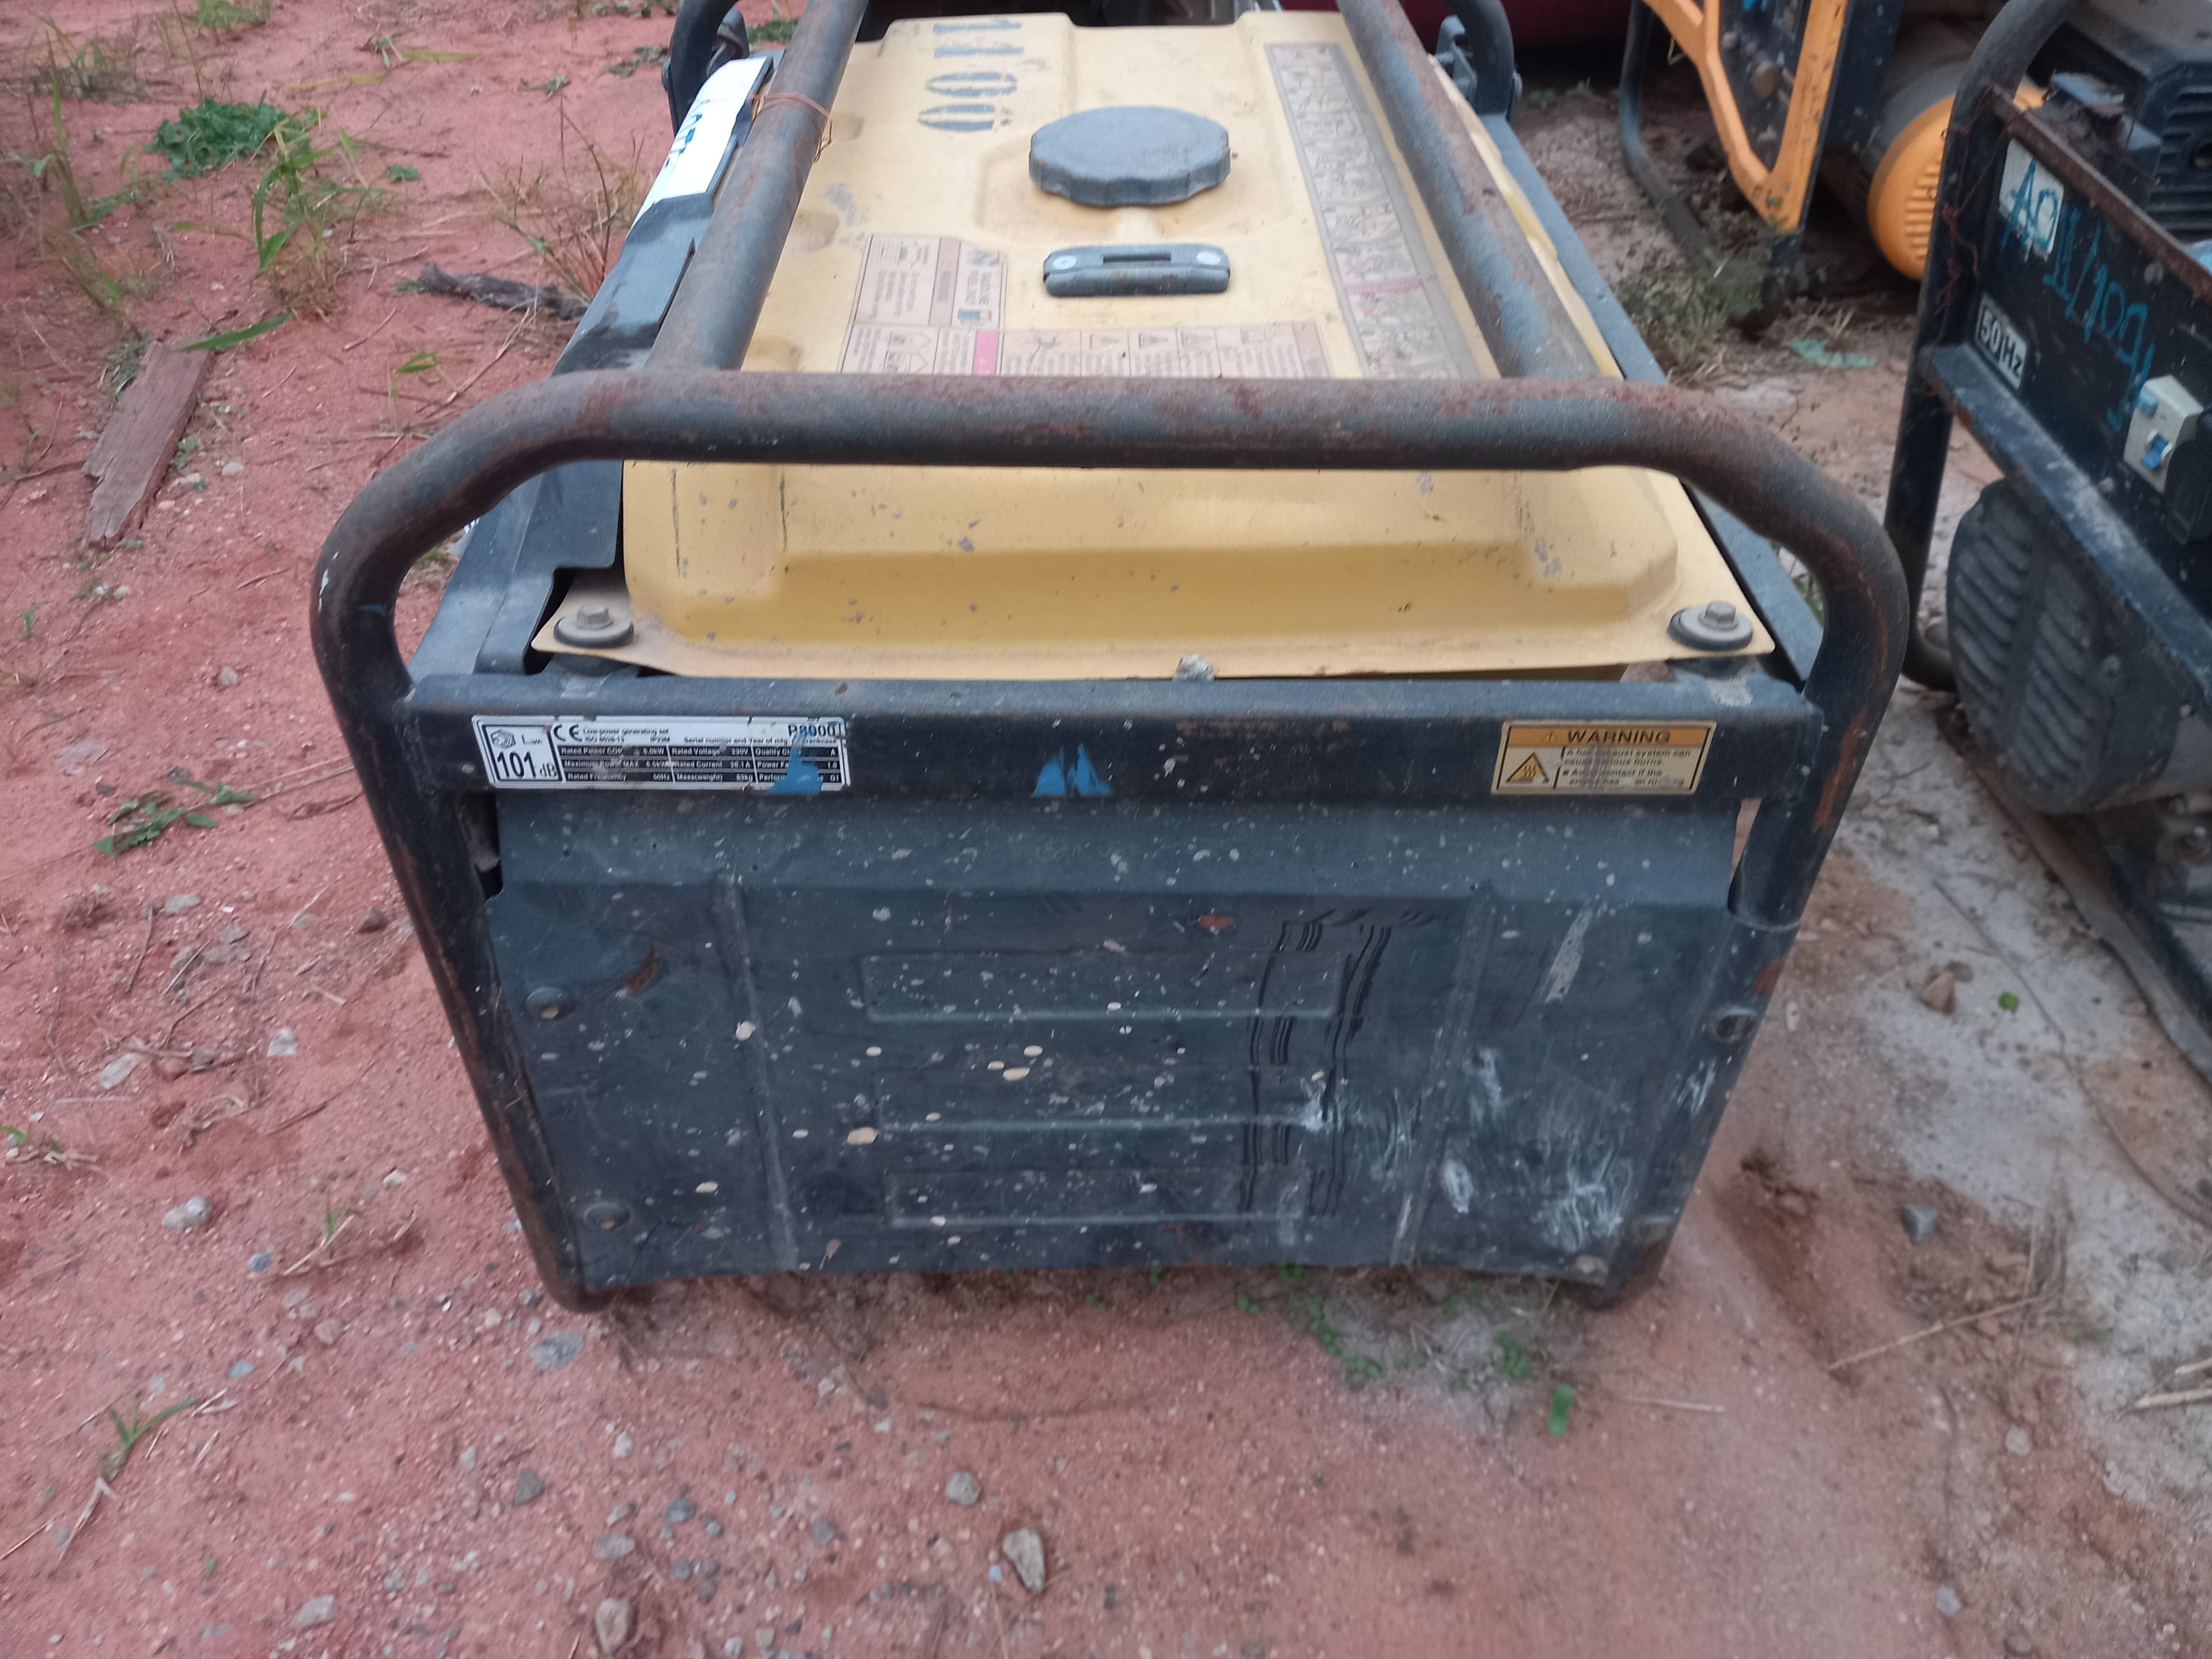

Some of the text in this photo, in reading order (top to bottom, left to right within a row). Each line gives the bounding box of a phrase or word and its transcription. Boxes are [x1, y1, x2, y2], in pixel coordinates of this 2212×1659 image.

[553, 724, 582, 742] CE
[1567, 730, 1671, 743] WARNING
[561, 747, 582, 755] Rated
[672, 747, 749, 756] Rated Voltage 230V
[755, 747, 780, 756] Quality
[1635, 750, 1671, 759] system
[497, 751, 557, 778] 101 dB
[757, 761, 779, 769] Power
